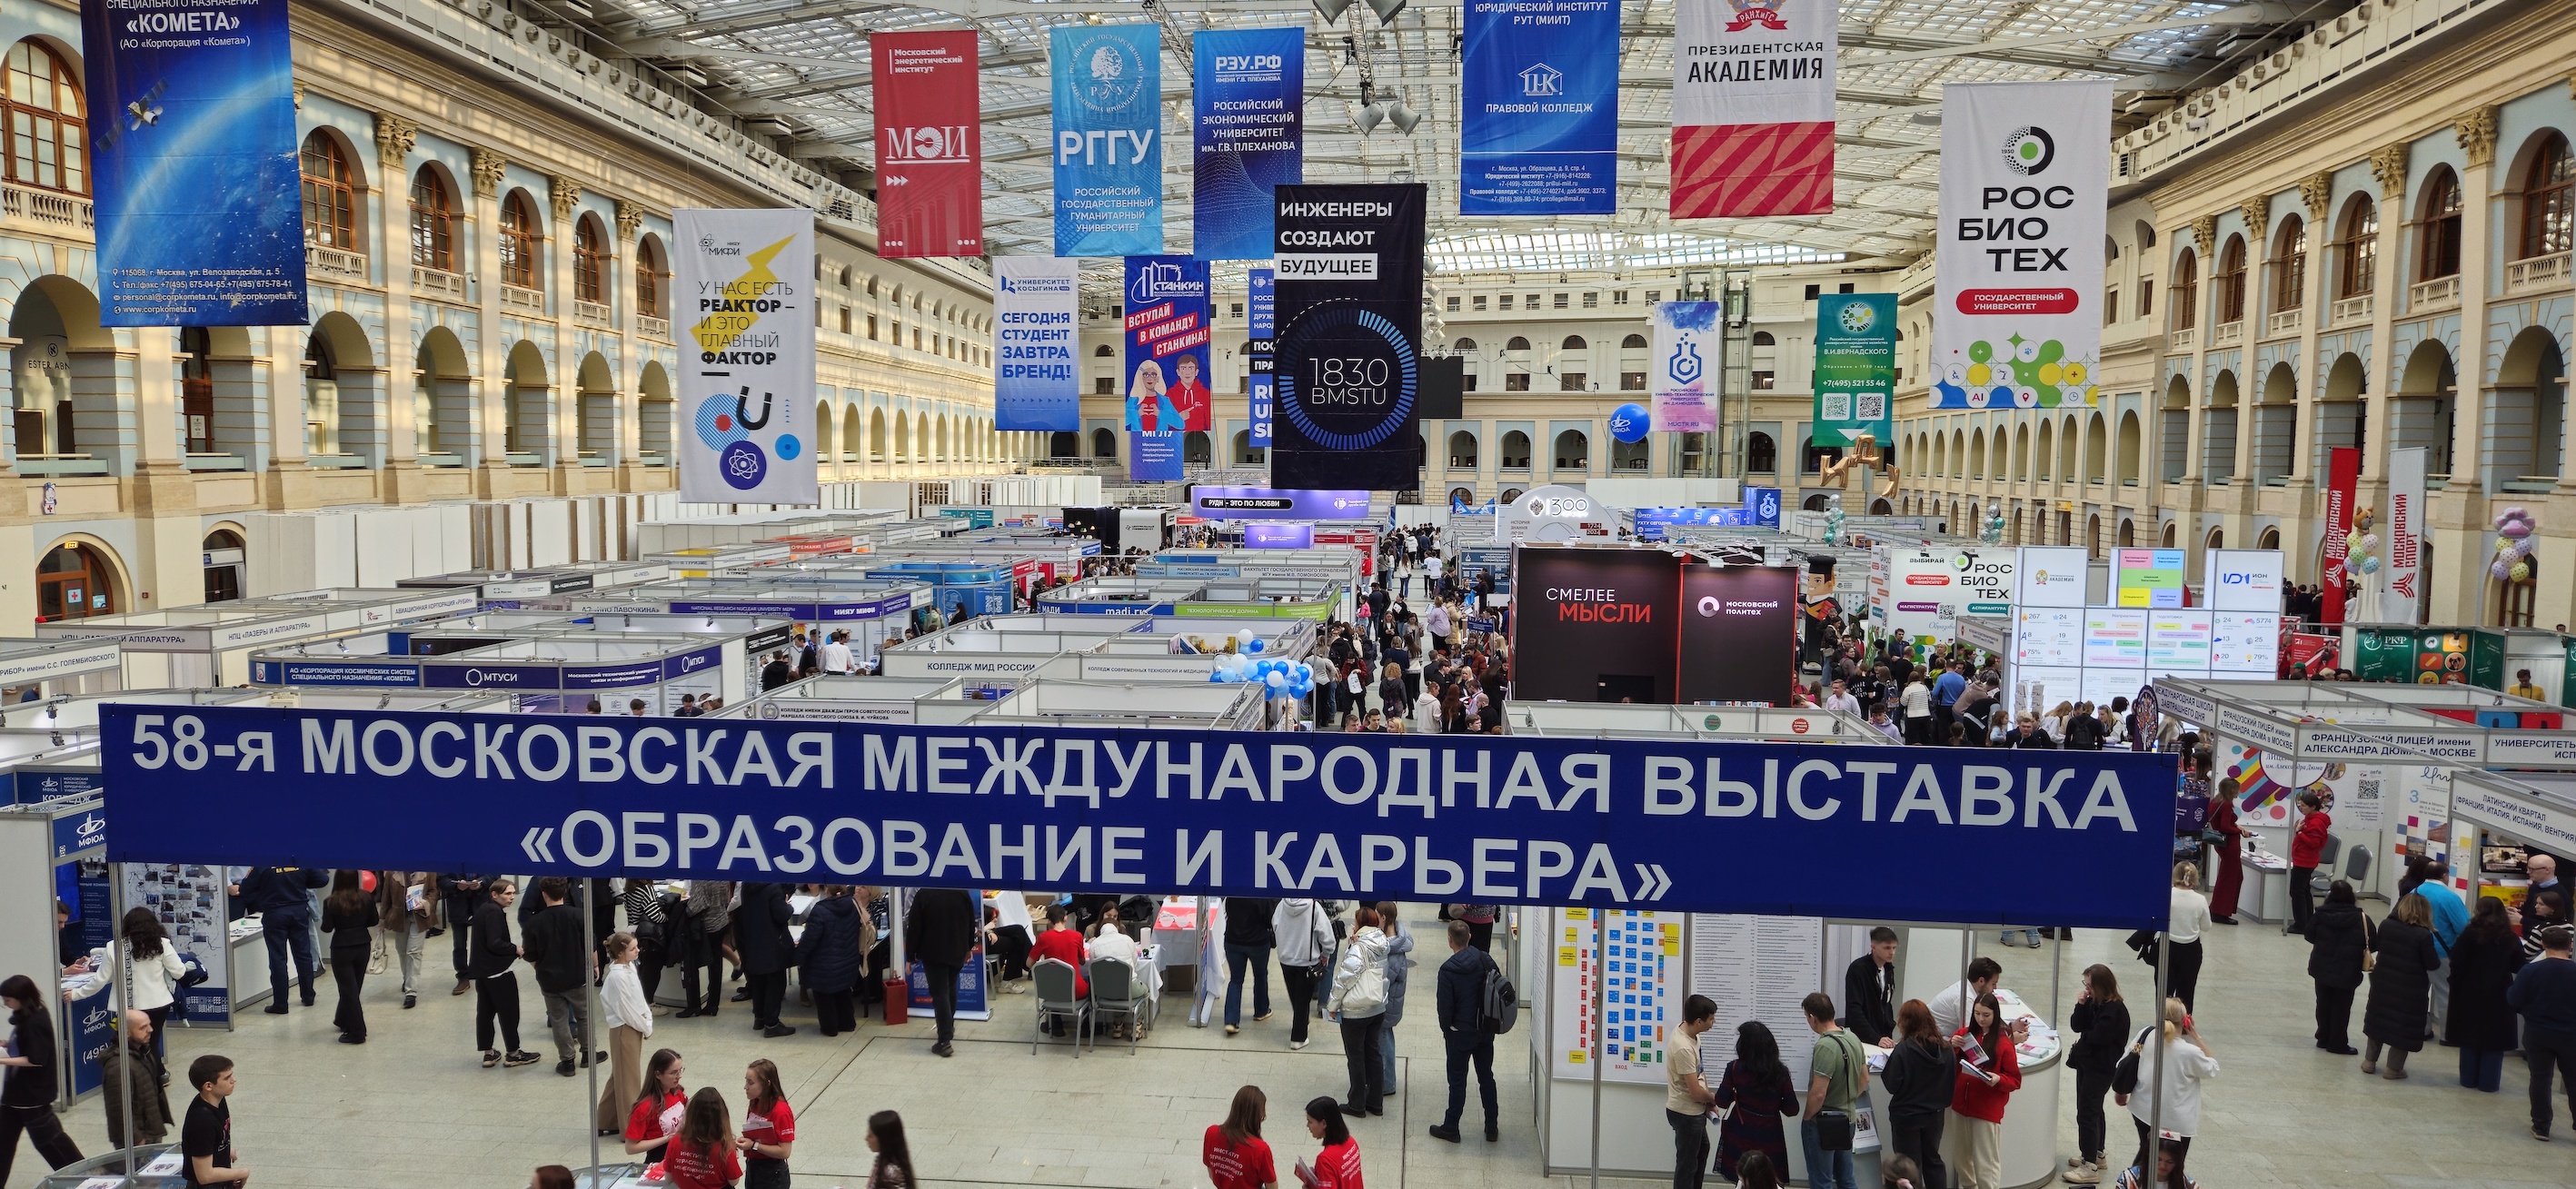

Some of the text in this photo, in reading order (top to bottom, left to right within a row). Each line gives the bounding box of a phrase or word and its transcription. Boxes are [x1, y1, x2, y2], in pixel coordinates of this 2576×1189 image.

[1476, 0, 1608, 13] ЮРИДИЧЕСКИЙ ИНСТИТУТ
[126, 12, 240, 33] «КОМЕТА»
[1514, 15, 1570, 25] РУТ (МИИТ)
[1739, 11, 1775, 23] РАНХиГС
[120, 35, 250, 50] (АО «Корпорация «Комета»)
[1688, 42, 1823, 55] ПРЕЗИДЕНТСКАЯ
[894, 47, 946, 56] Московский
[895, 55, 962, 65] энергетический
[1216, 54, 1281, 70] РЭУ.РФ
[895, 65, 933, 74] институт
[1688, 58, 1823, 83] АКАДЕМИЯ
[1214, 97, 1283, 110] РОССИЙСКИЙ
[1487, 102, 1593, 114] ПРАВОВОЙ КОЛЛЕДЖ
[1202, 112, 1294, 124] ЭКОНОМИЧЕСКИЙ
[1213, 127, 1284, 138] УНИВЕРСИТЕТ
[885, 126, 970, 159] МЭИ
[1059, 129, 1154, 165] РГГУ
[1075, 186, 1140, 196] РОССИЙСКИЙ
[1983, 185, 2074, 210] РОС
[1062, 198, 1154, 209] ГОСУДАРСТВЕННЫЙ
[1281, 202, 1392, 216] ИНЖЕНЕРЫ
[1070, 210, 1145, 221] ГУМАНИТАРНЫЙ
[1076, 223, 1139, 233] УНИВЕРСИТЕТ
[1958, 217, 2048, 241] БИО
[1280, 231, 1375, 247] СОЗДАЮТ
[709, 247, 740, 255] МИФИ
[1986, 247, 2069, 272] ТЕХ
[1281, 260, 1371, 275] БУДУЩЕЕ
[699, 282, 792, 295] У НАС ЕСТЬ
[1154, 282, 1204, 291] СТАНКИН
[1974, 292, 2064, 302] ГОСУДАРСТВЕННЫЙ
[124, 306, 196, 314] www.corpkometa.ru
[701, 299, 781, 312] РЕАКТОР
[1002, 312, 1069, 325] СЕГОДНЯ
[1129, 302, 1170, 329] ВСТУПАЙ
[701, 316, 749, 330] И ЭТО
[1140, 314, 1194, 342] В КОМАНДУ
[701, 332, 779, 347] ГЛАВНЫЙ
[1002, 330, 1069, 342] СТУДЕНТ
[1157, 330, 1207, 356] СТАНКИНА!
[701, 352, 776, 364] ФАКТОР
[1002, 346, 1069, 359] ЗАВТРА
[1003, 365, 1070, 381] БРЕНД!
[1309, 358, 1387, 386] 1830
[1312, 388, 1386, 404] BMSTU
[2326, 490, 2342, 559] МОСКОВСКИЙ
[2393, 494, 2407, 568] МОСКОВСКИЙ
[2335, 528, 2348, 560] СПОРТ
[2405, 533, 2417, 568] СПОРТ
[1974, 564, 2013, 574] РОС
[1961, 577, 1998, 586] БИО
[1546, 588, 1616, 602] СМЕЛЕЕ
[1975, 590, 2009, 599] ТЕХ
[395, 604, 427, 614] АВИАЦИОННАЯ
[428, 600, 454, 609] КОРПОРАЦИЯ
[1559, 602, 1651, 623] МЫСЛИ
[243, 629, 268, 639] «ЛАЗЕРЫ
[274, 623, 310, 633] АППАРАТУРА»
[47, 661, 59, 669] С.С.
[61, 653, 115, 667] ГОЛЕМБИОВСКОГО
[927, 662, 1035, 672] КОЛЛЕДЖ МИД РОССИИ
[484, 673, 518, 681] МТУСИ
[2220, 719, 2251, 735] АЛЕКСАНДРА
[2251, 730, 2267, 742] ДЮМА
[2272, 737, 2293, 750] МОСКВЕ
[2396, 733, 2434, 746] ЛИЦЕЙ
[132, 713, 2139, 832] 58-я МОСКОВСКАЯ МЕЖДУНАРОДНАЯ ВЫСТАВКА
[2410, 789, 2419, 803] 3
[79, 834, 104, 847] МФЮА
[520, 809, 1674, 903] «ОБРАЗОВАНИЕ И КАРЬЕРА»
[85, 1021, 106, 1035] МФЮА
